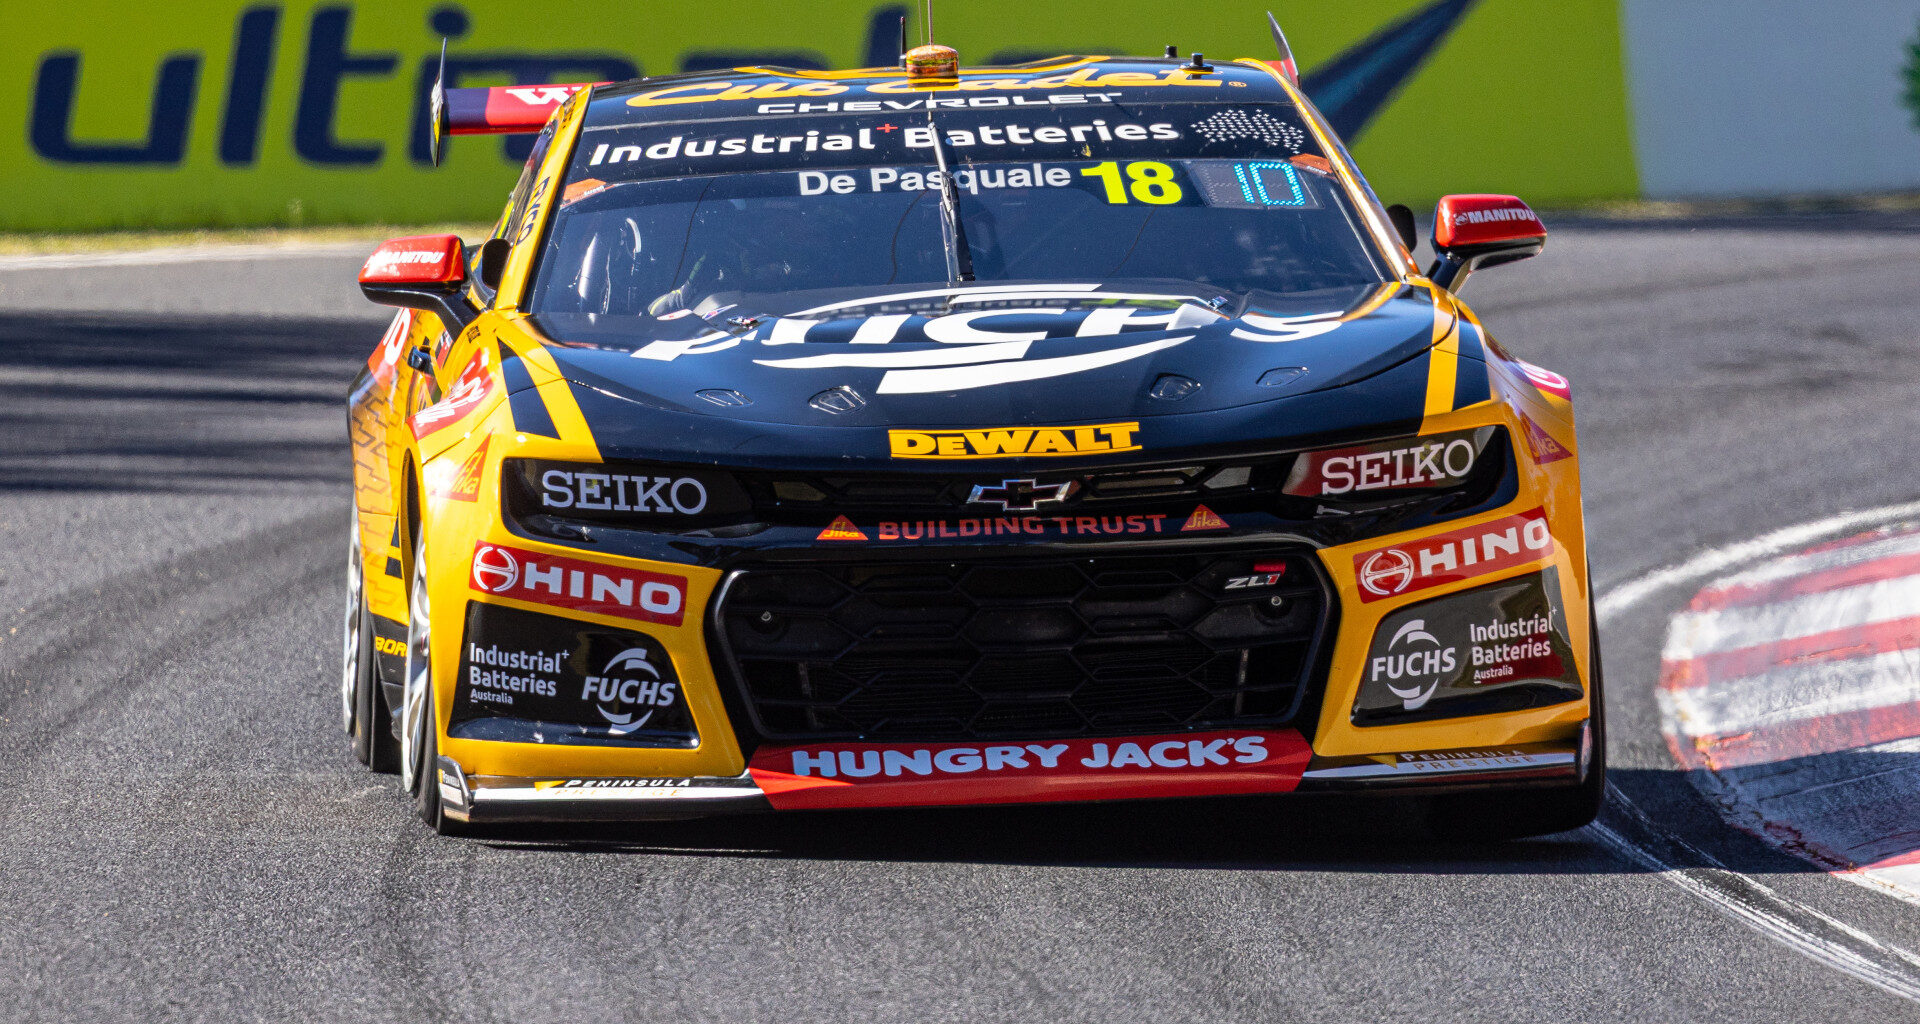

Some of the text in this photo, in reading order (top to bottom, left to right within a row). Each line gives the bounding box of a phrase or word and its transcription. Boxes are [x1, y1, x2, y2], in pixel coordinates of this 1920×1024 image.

[28, 4, 1128, 167] ultim
[626, 68, 1222, 107] Cub Cadet
[757, 92, 1121, 114] CHEVROLET
[904, 119, 1180, 149] Batteries
[799, 163, 1071, 196] De Pasquale
[1081, 161, 1182, 205] 18
[1234, 161, 1304, 206] 10
[1467, 207, 1536, 224] MANITOU
[1321, 438, 1475, 495] SEIKO
[541, 469, 708, 515] SEIKO
[823, 521, 859, 539] Sika
[879, 514, 1167, 541] BUILDING TRUST
[1186, 511, 1221, 530] Sika
[1420, 517, 1551, 577] HINO
[524, 563, 682, 615] HINO
[1225, 572, 1283, 590] ZL1
[374, 636, 409, 657] BOR
[1471, 638, 1551, 667] Batteries
[1371, 646, 1456, 682] FUCHS
[1473, 664, 1514, 684] Australia
[469, 666, 557, 698] Batteries
[470, 688, 513, 705] Australia
[582, 676, 676, 708] FUCHS
[791, 735, 1269, 778] HUNGRY JACK'S
[1401, 749, 1526, 763] PENINSULA
[1412, 755, 1538, 771] PRESTIGE
[564, 779, 691, 788] PENINSULA
